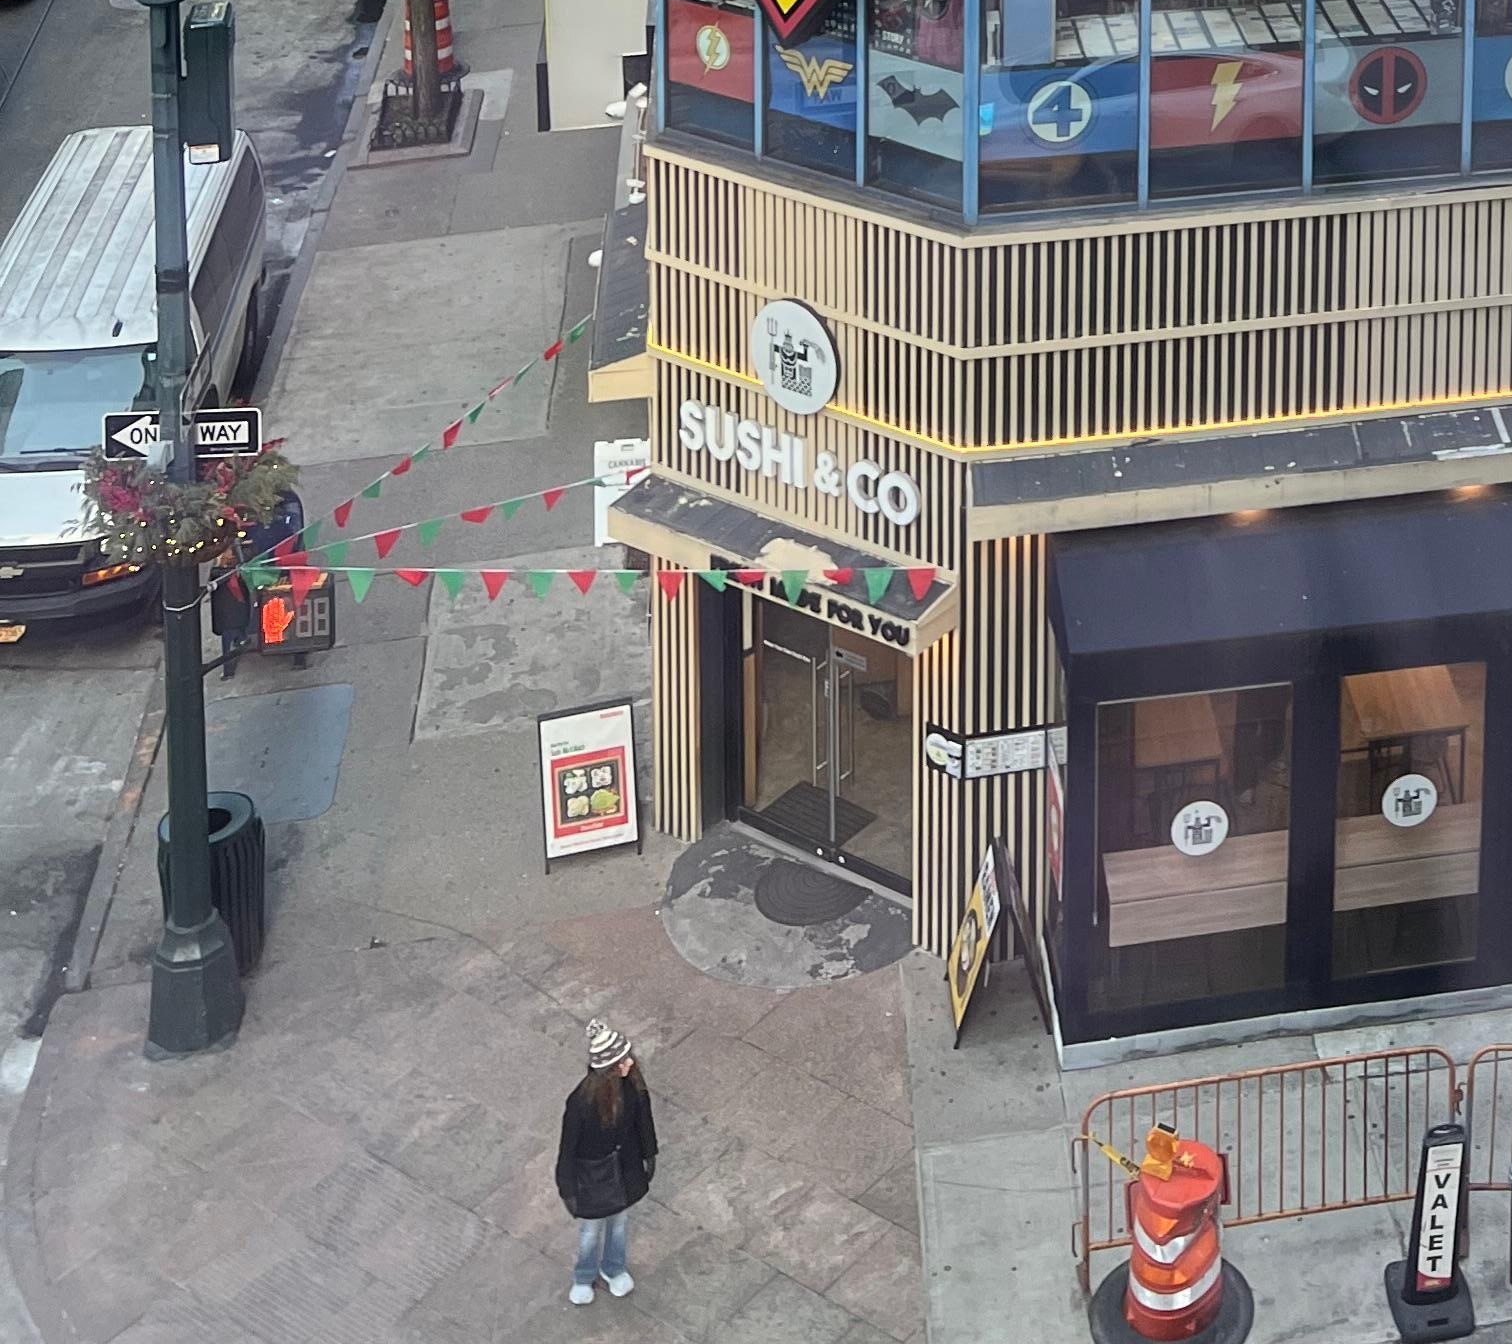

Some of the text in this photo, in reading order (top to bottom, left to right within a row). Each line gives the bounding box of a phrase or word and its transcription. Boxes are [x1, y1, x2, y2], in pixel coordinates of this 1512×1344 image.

[130, 424, 242, 445] ON WAY
[679, 399, 922, 527] SUSHI & CO
[769, 576, 911, 647] MDE FOR YOU
[1426, 1172, 1452, 1272] VALET
